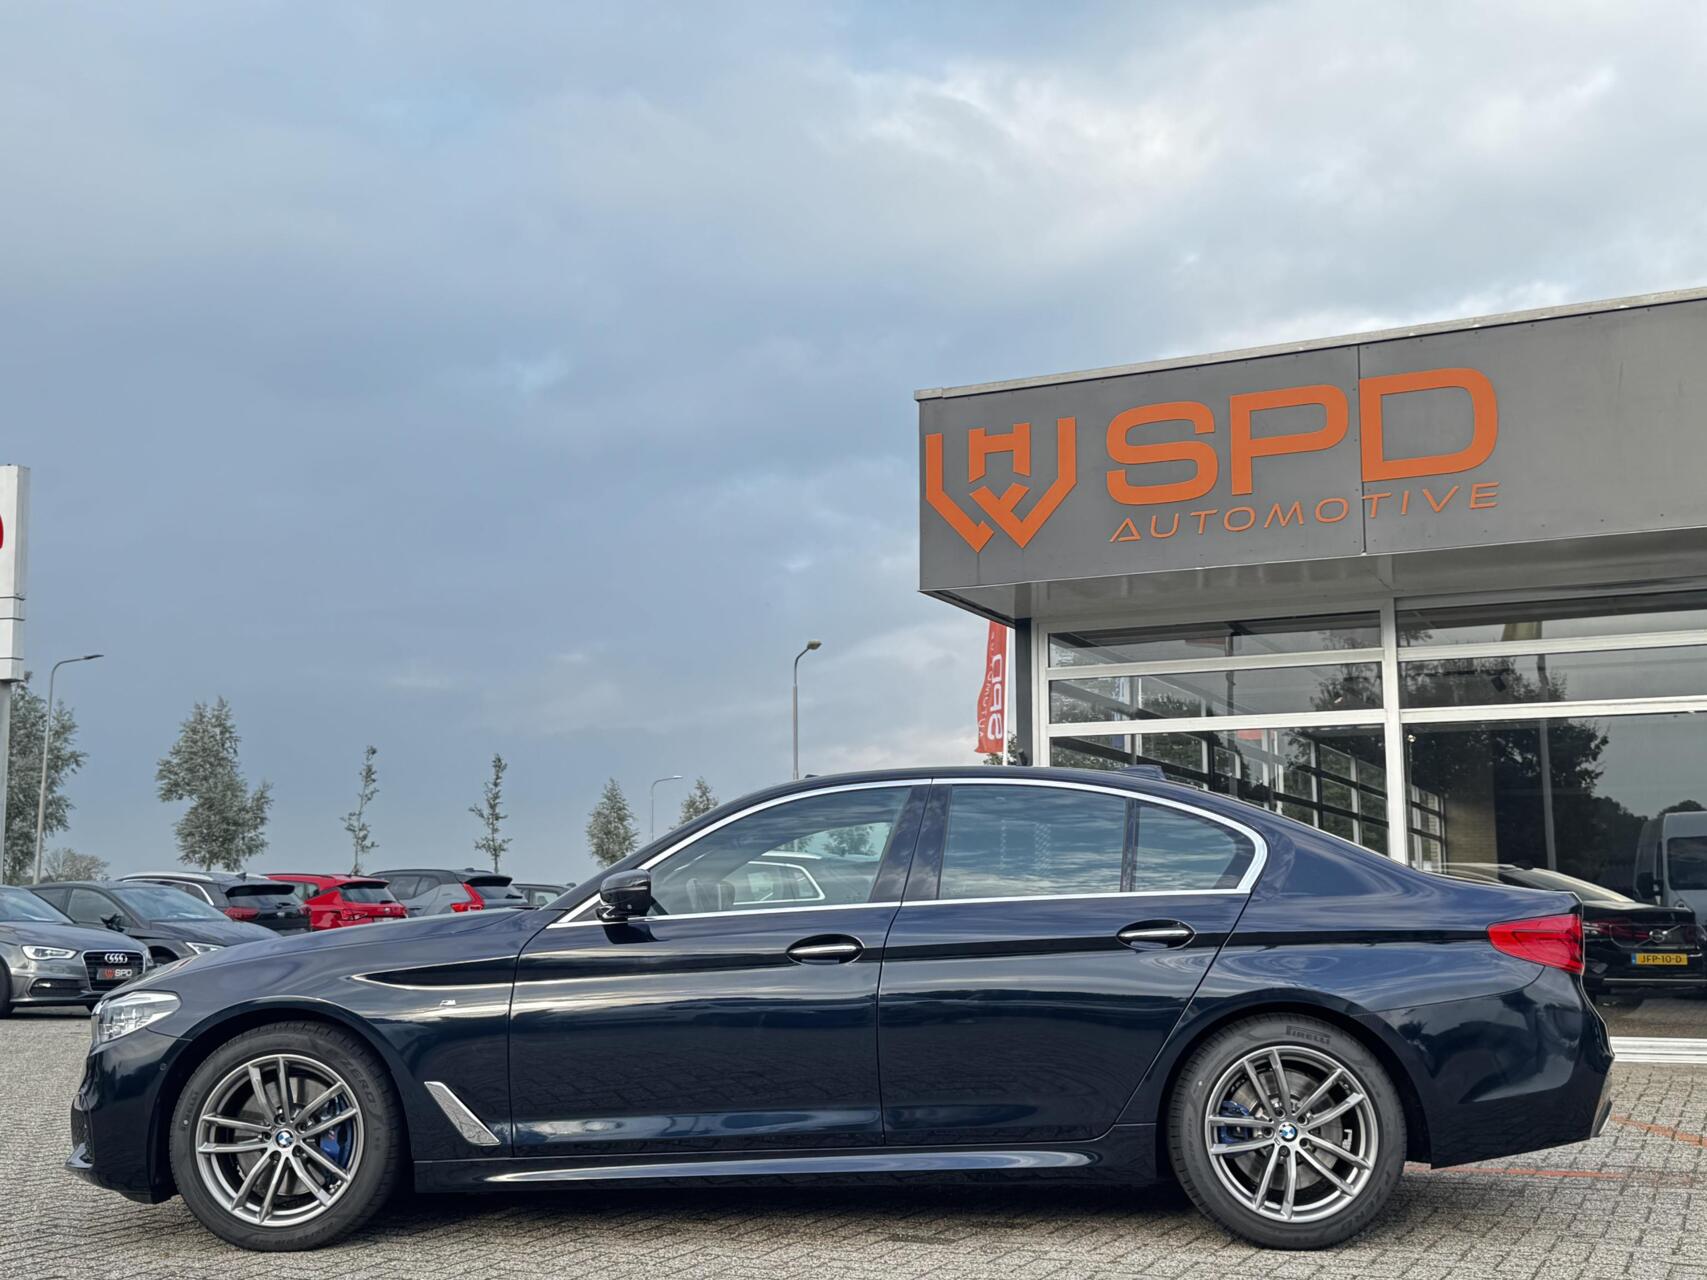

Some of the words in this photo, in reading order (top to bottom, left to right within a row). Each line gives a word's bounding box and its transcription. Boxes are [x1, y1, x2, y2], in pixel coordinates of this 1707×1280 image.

[1106, 367, 1499, 506] SPD
[1109, 481, 1500, 543] AUTOMOTIVE
[1640, 954, 1682, 964] JFP-10-D
[1285, 1024, 1331, 1045] PIRELLI
